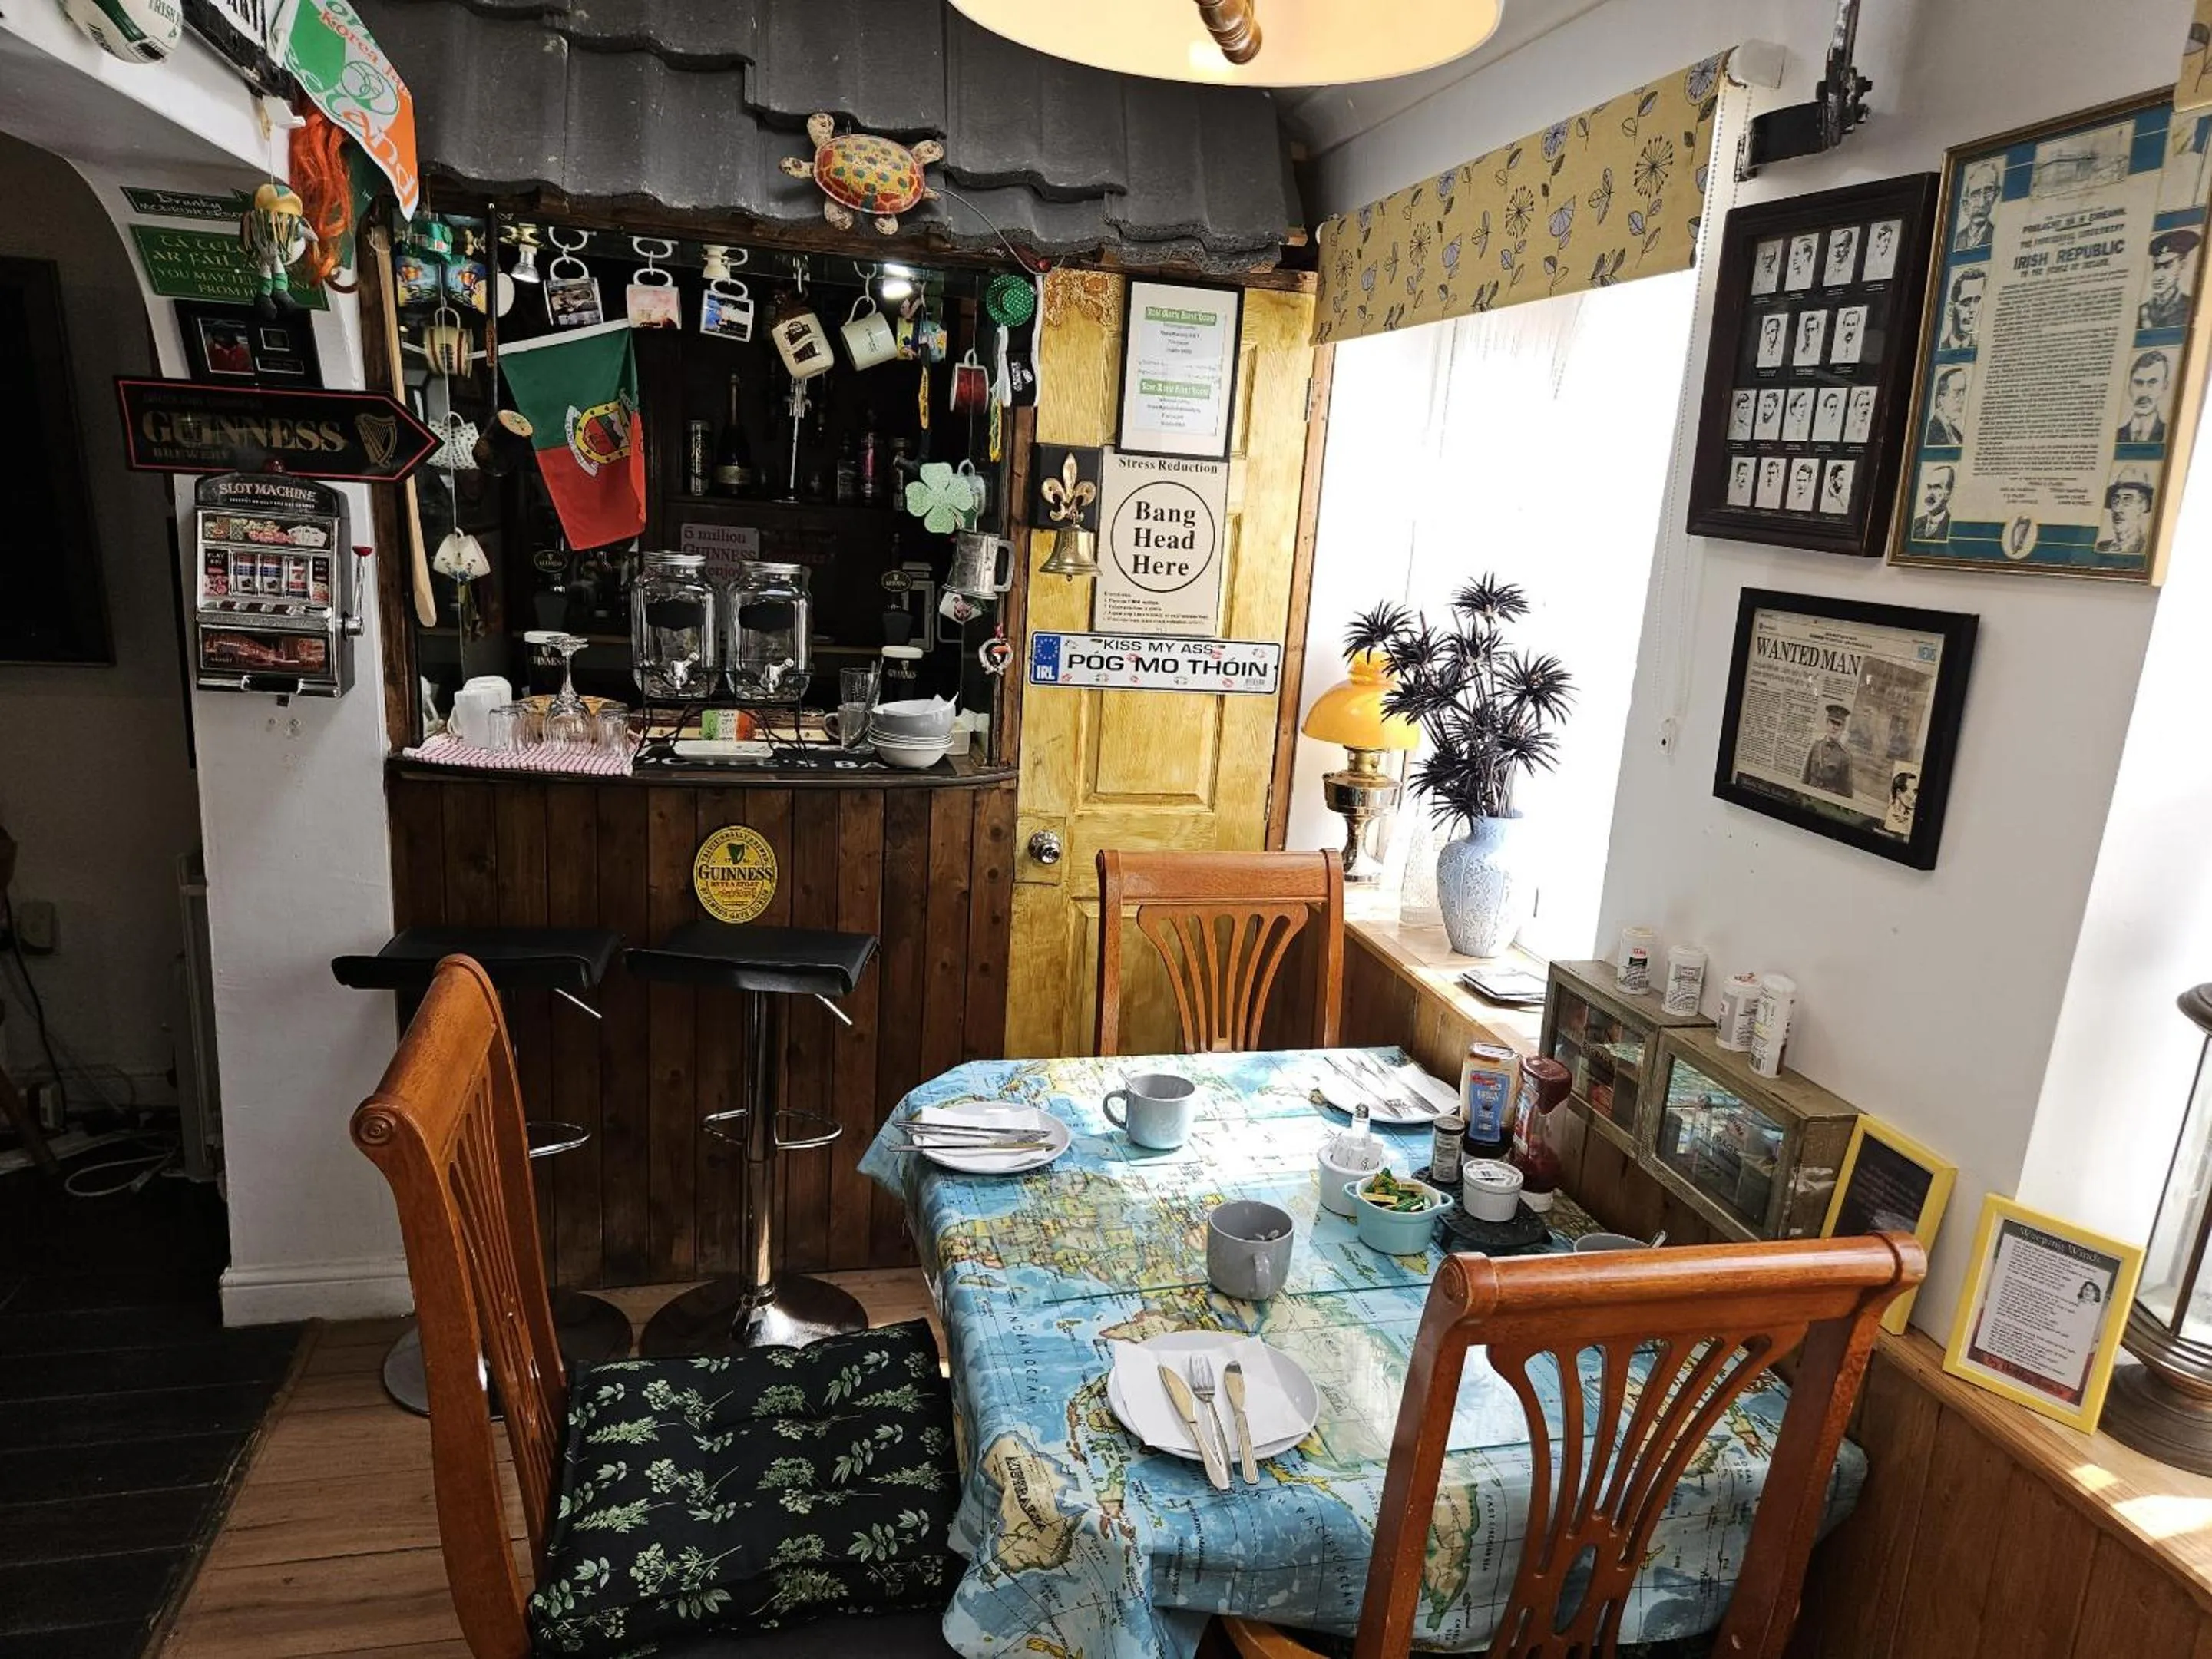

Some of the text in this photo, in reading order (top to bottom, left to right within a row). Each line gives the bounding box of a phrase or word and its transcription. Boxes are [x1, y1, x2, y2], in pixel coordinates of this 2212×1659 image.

[319, 9, 378, 64] Korea
[2013, 252, 2049, 269] IRISH
[2056, 239, 2125, 263] REPUBLIC
[193, 271, 224, 283] MAY
[142, 410, 347, 452] GUINNESS
[1119, 458, 1218, 474] Stress Reduction
[219, 483, 316, 502] SLOT MACHINE
[1135, 501, 1196, 528] Bang
[698, 528, 746, 544] million
[1133, 527, 1195, 550] Head
[1132, 554, 1189, 576] Here
[1103, 639, 1213, 654] KISS MY ASS
[1757, 636, 1820, 667] WANTED
[1820, 649, 1861, 676] MAN
[1037, 665, 1055, 680] IRL
[1068, 651, 1267, 677] PÓG MO THÓIN
[698, 864, 773, 882] GUINNESS
[1024, 1359, 1038, 1403] OCEAN
